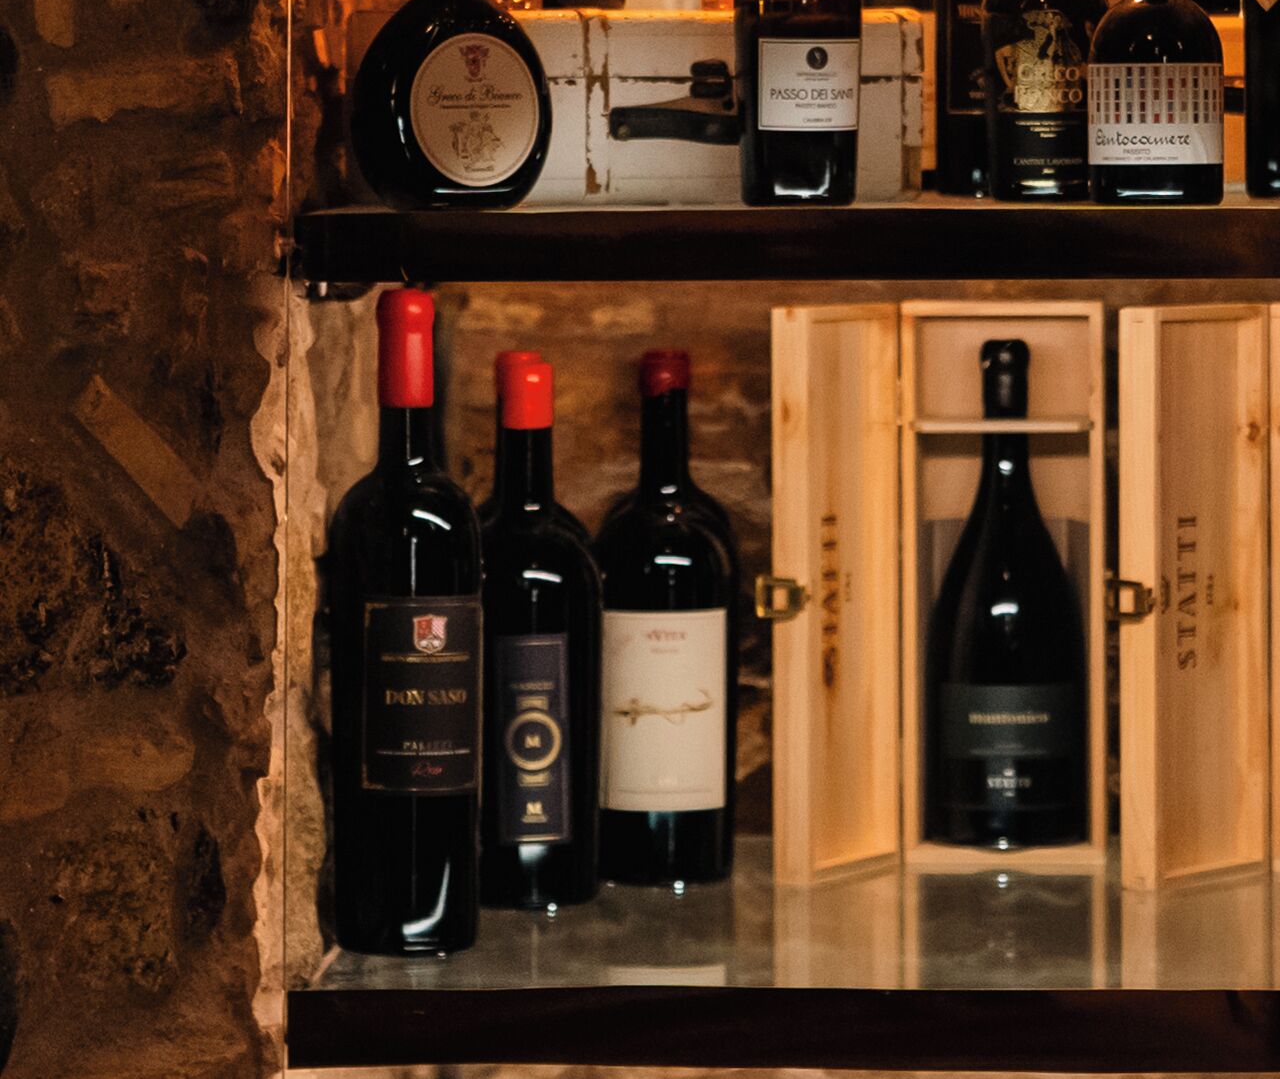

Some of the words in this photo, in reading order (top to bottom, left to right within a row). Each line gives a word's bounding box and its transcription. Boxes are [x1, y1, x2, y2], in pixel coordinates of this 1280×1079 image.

[770, 87, 808, 101] PASSO
[810, 88, 829, 101] DEI
[1176, 516, 1197, 670] STATTI
[385, 689, 425, 706] DON
